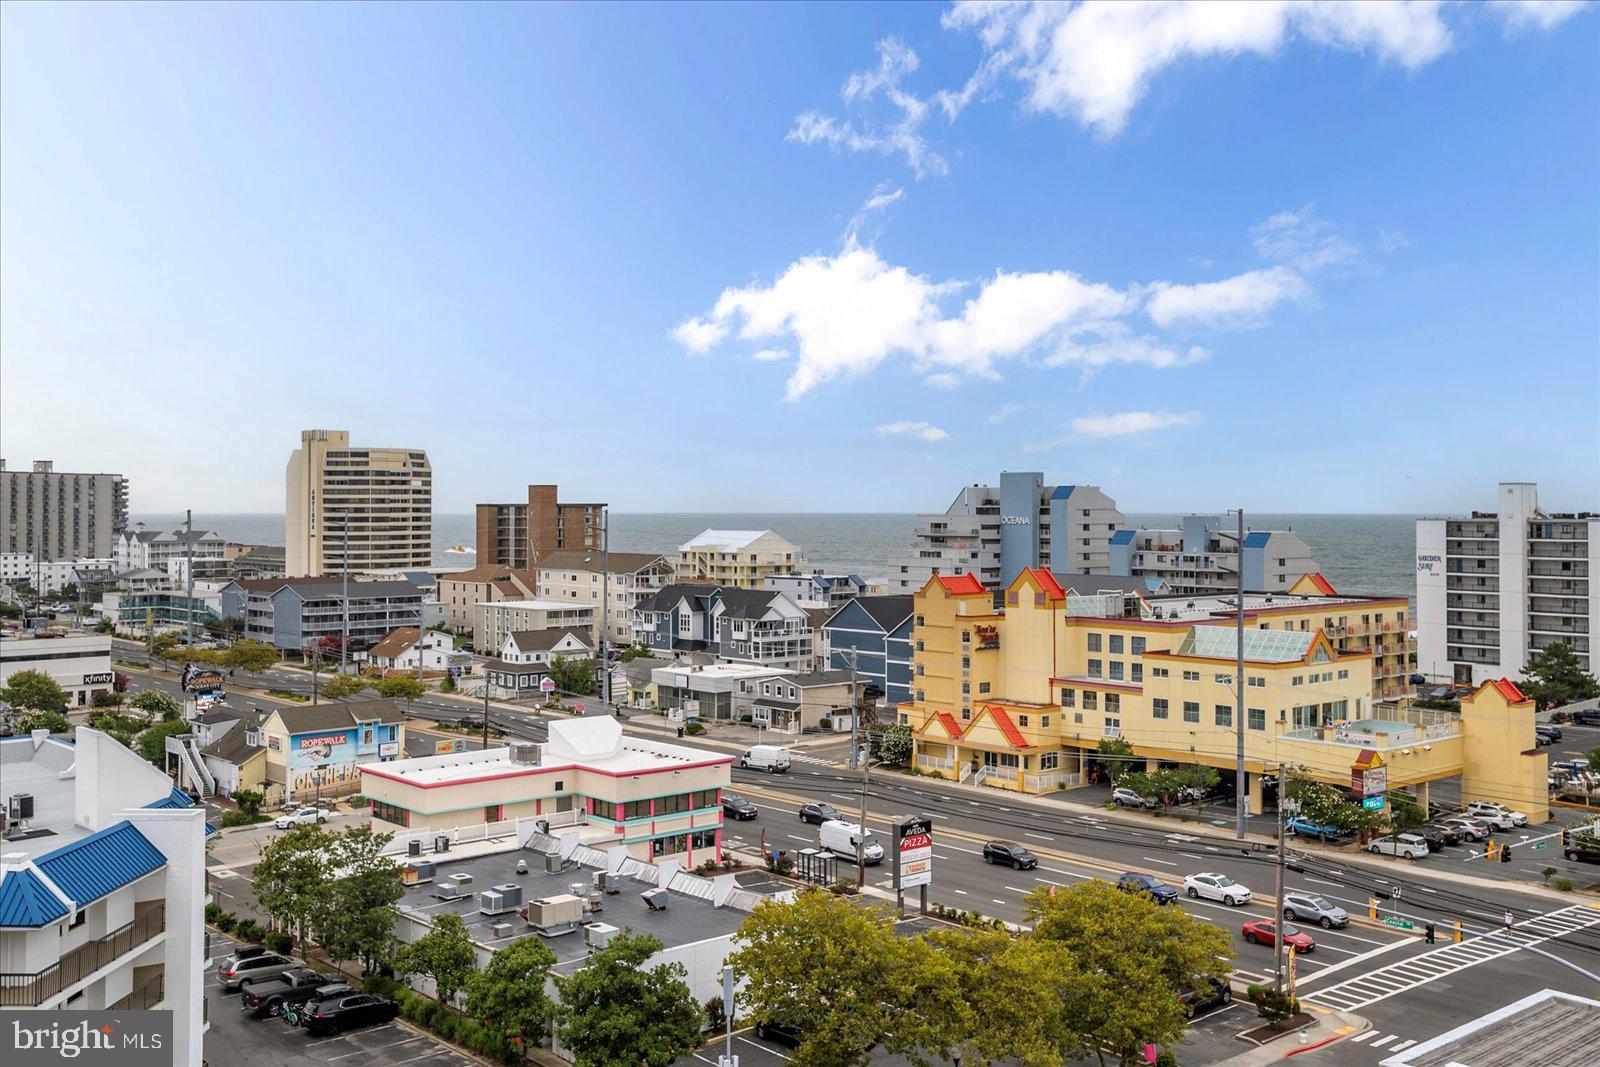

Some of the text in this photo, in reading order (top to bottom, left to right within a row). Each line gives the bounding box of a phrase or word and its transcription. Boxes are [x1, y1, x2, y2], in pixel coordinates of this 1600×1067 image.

[1001, 515, 1030, 525] OCEANA
[84, 674, 112, 684] xfinity
[191, 676, 224, 687] ROPEWALK
[301, 735, 346, 748] ROPEWALK
[905, 827, 927, 836] AVEDA
[904, 836, 928, 848] PIZZA
[1385, 918, 1404, 927] Coastal
